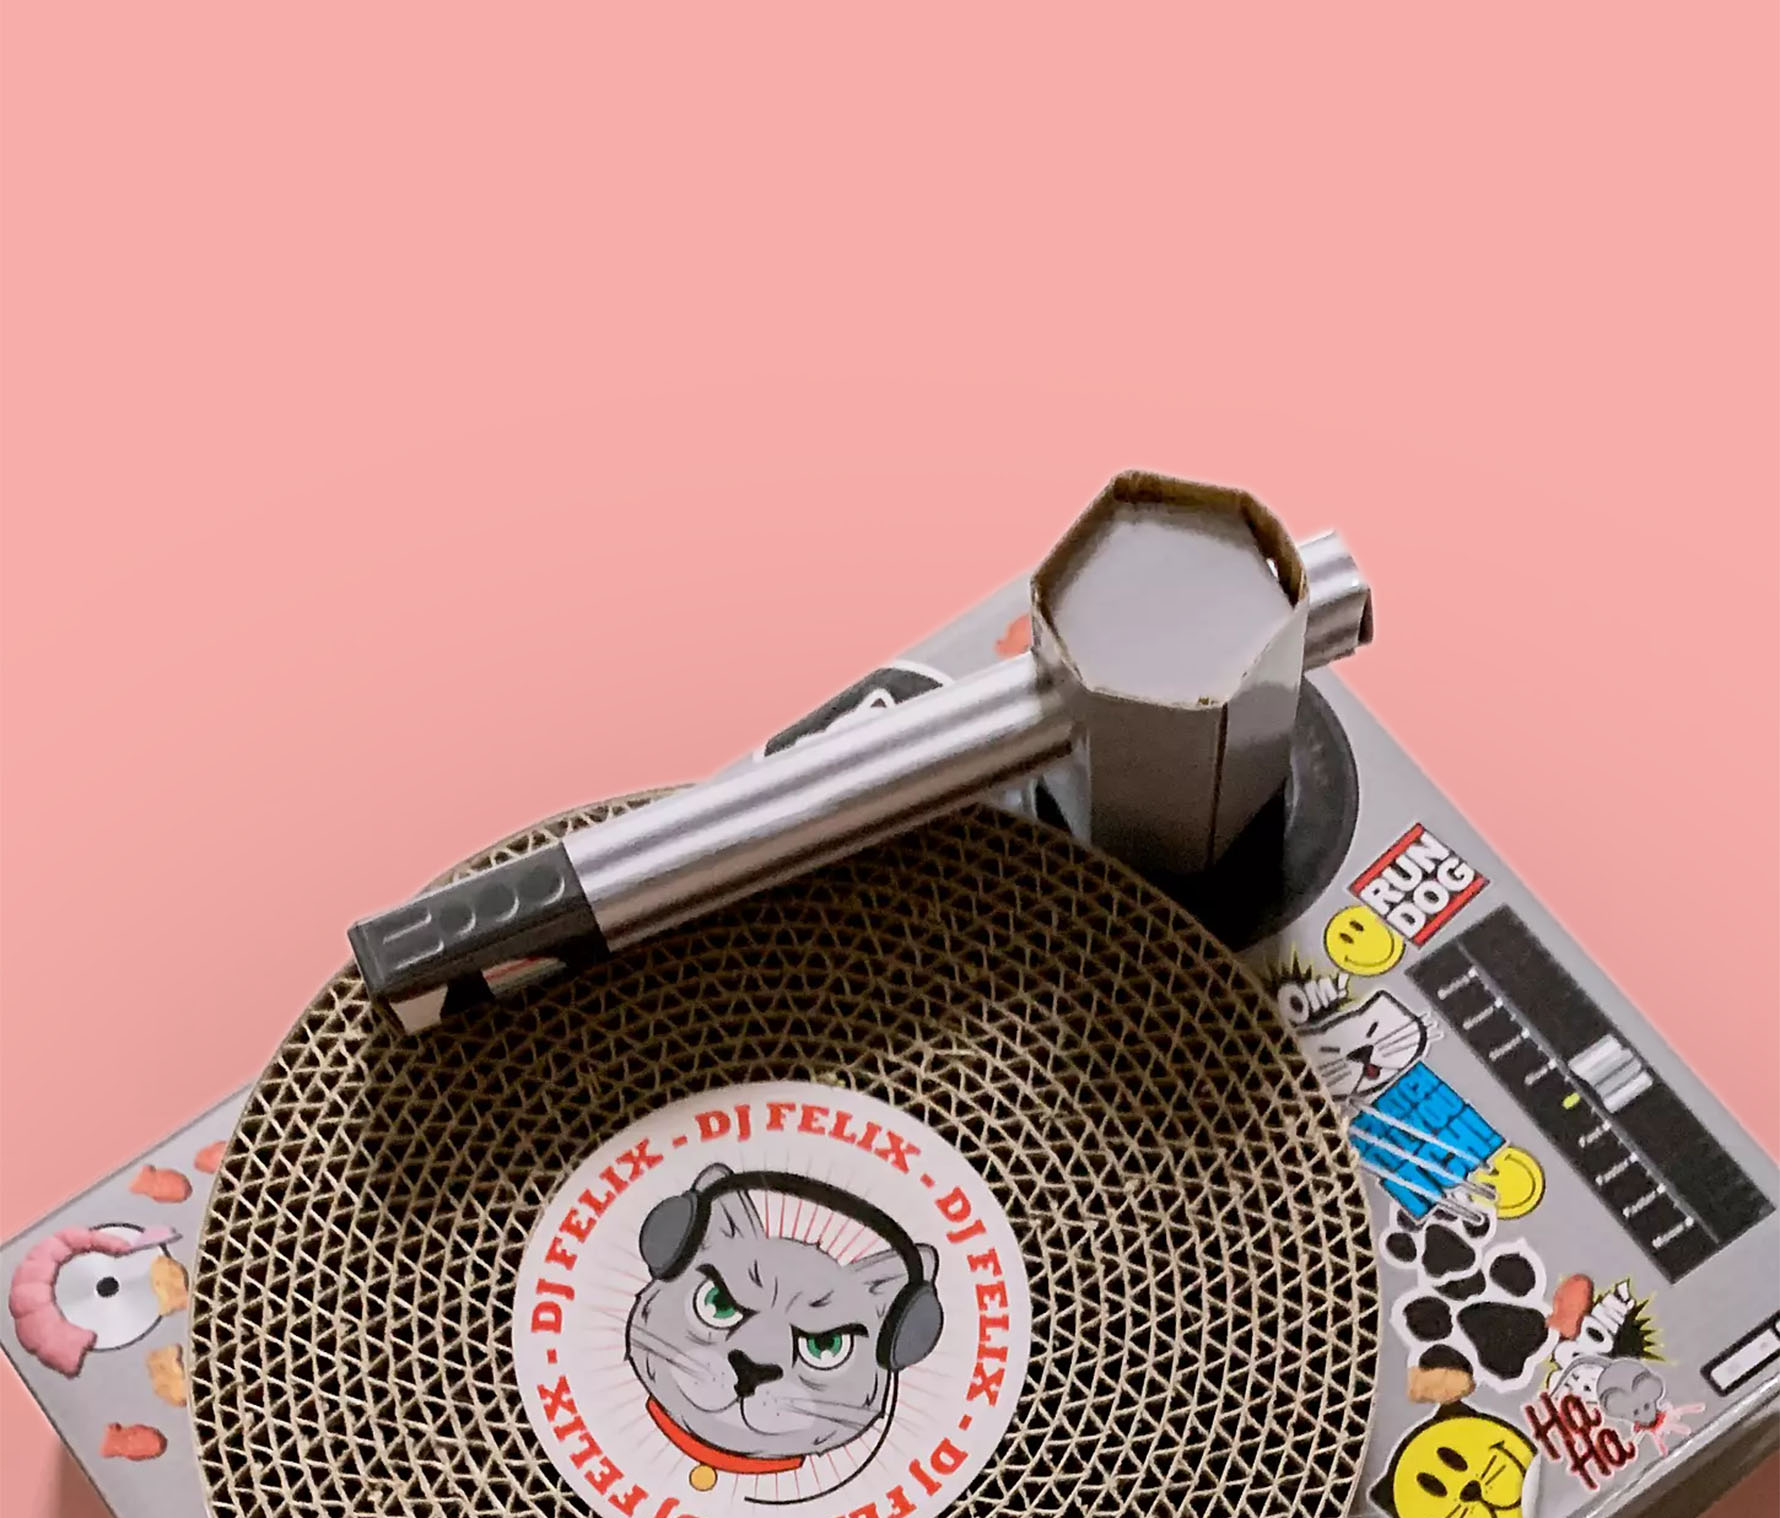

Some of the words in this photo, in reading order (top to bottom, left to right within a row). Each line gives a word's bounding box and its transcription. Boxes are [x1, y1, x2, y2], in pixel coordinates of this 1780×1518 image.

[1360, 831, 1450, 915] RUN
[1386, 858, 1475, 938] DOG
[693, 1103, 752, 1143] DJ
[765, 1100, 921, 1174] FELIX
[543, 1137, 665, 1272] FELIX
[529, 1276, 576, 1335] DJ
[935, 1185, 988, 1245] DJ
[965, 1247, 1011, 1408] FELIX
[536, 1375, 649, 1518] FELIX
[1525, 1392, 1603, 1460] Ha
[1564, 1427, 1636, 1489] Ha
[908, 1436, 969, 1497] DJ
